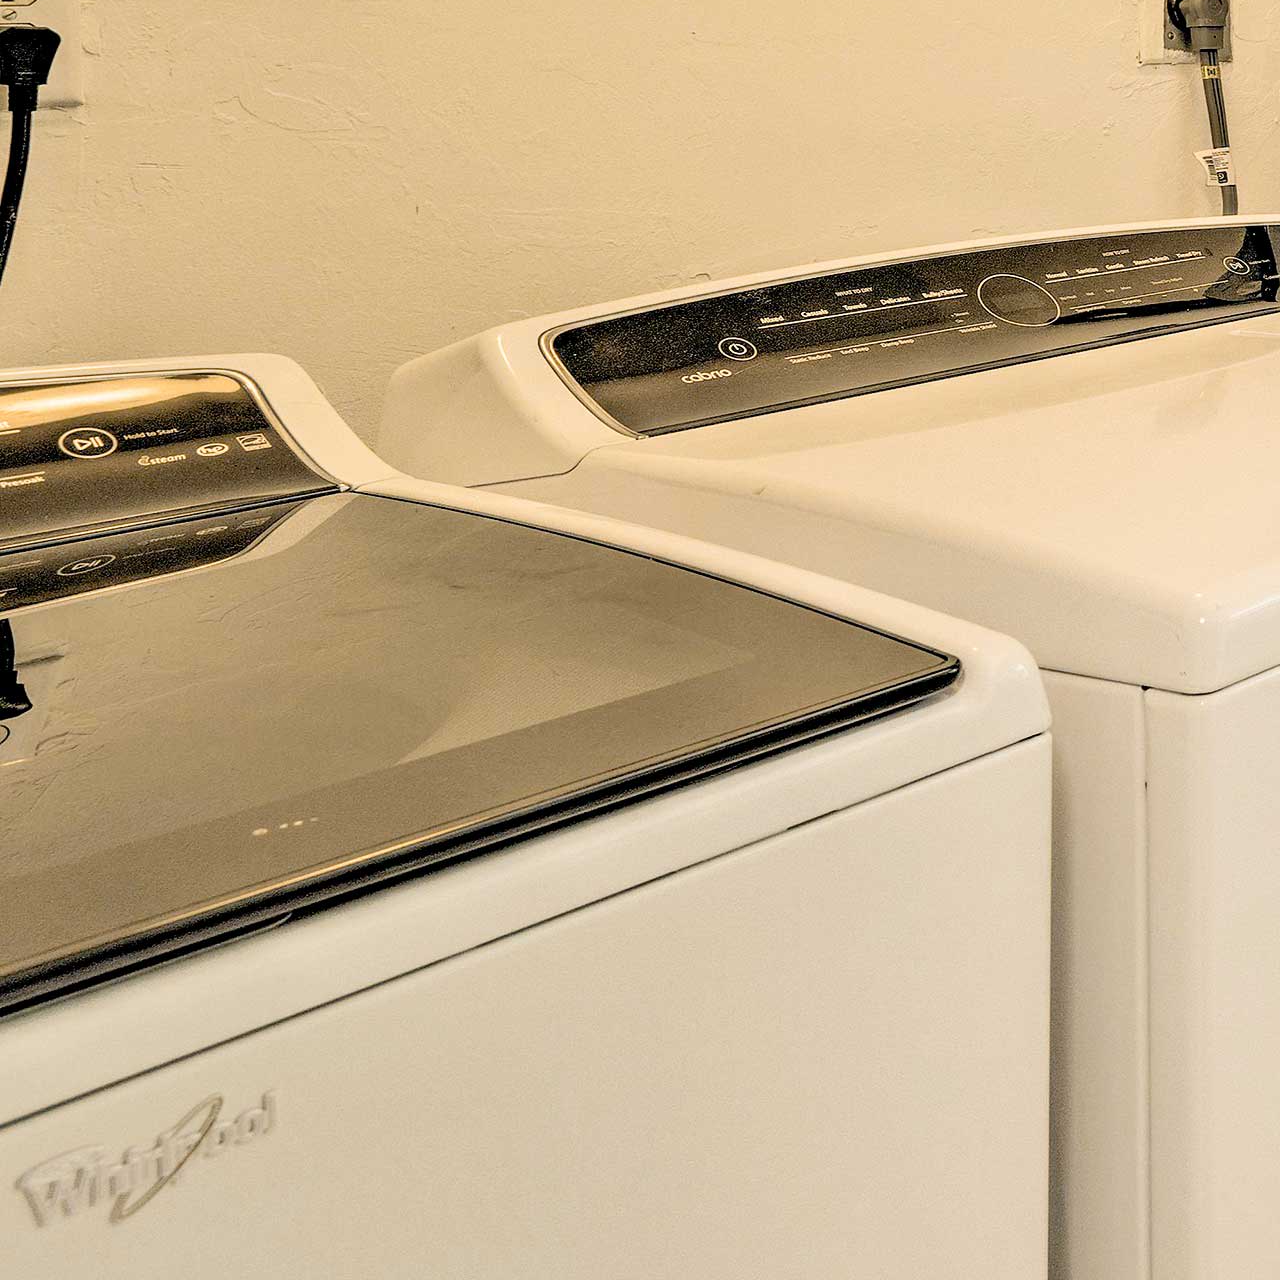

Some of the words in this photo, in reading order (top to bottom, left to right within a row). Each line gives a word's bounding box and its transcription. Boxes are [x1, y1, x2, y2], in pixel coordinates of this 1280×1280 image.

[880, 296, 911, 305] Delicates
[842, 302, 868, 311] Towels
[800, 309, 828, 318] Casuals
[760, 315, 785, 325] Mixed
[681, 368, 732, 384] cabrio
[123, 431, 146, 441] Hold
[150, 454, 187, 465] steam
[0, 475, 46, 489] Presoak
[14, 1089, 278, 1229] Whirlpool
